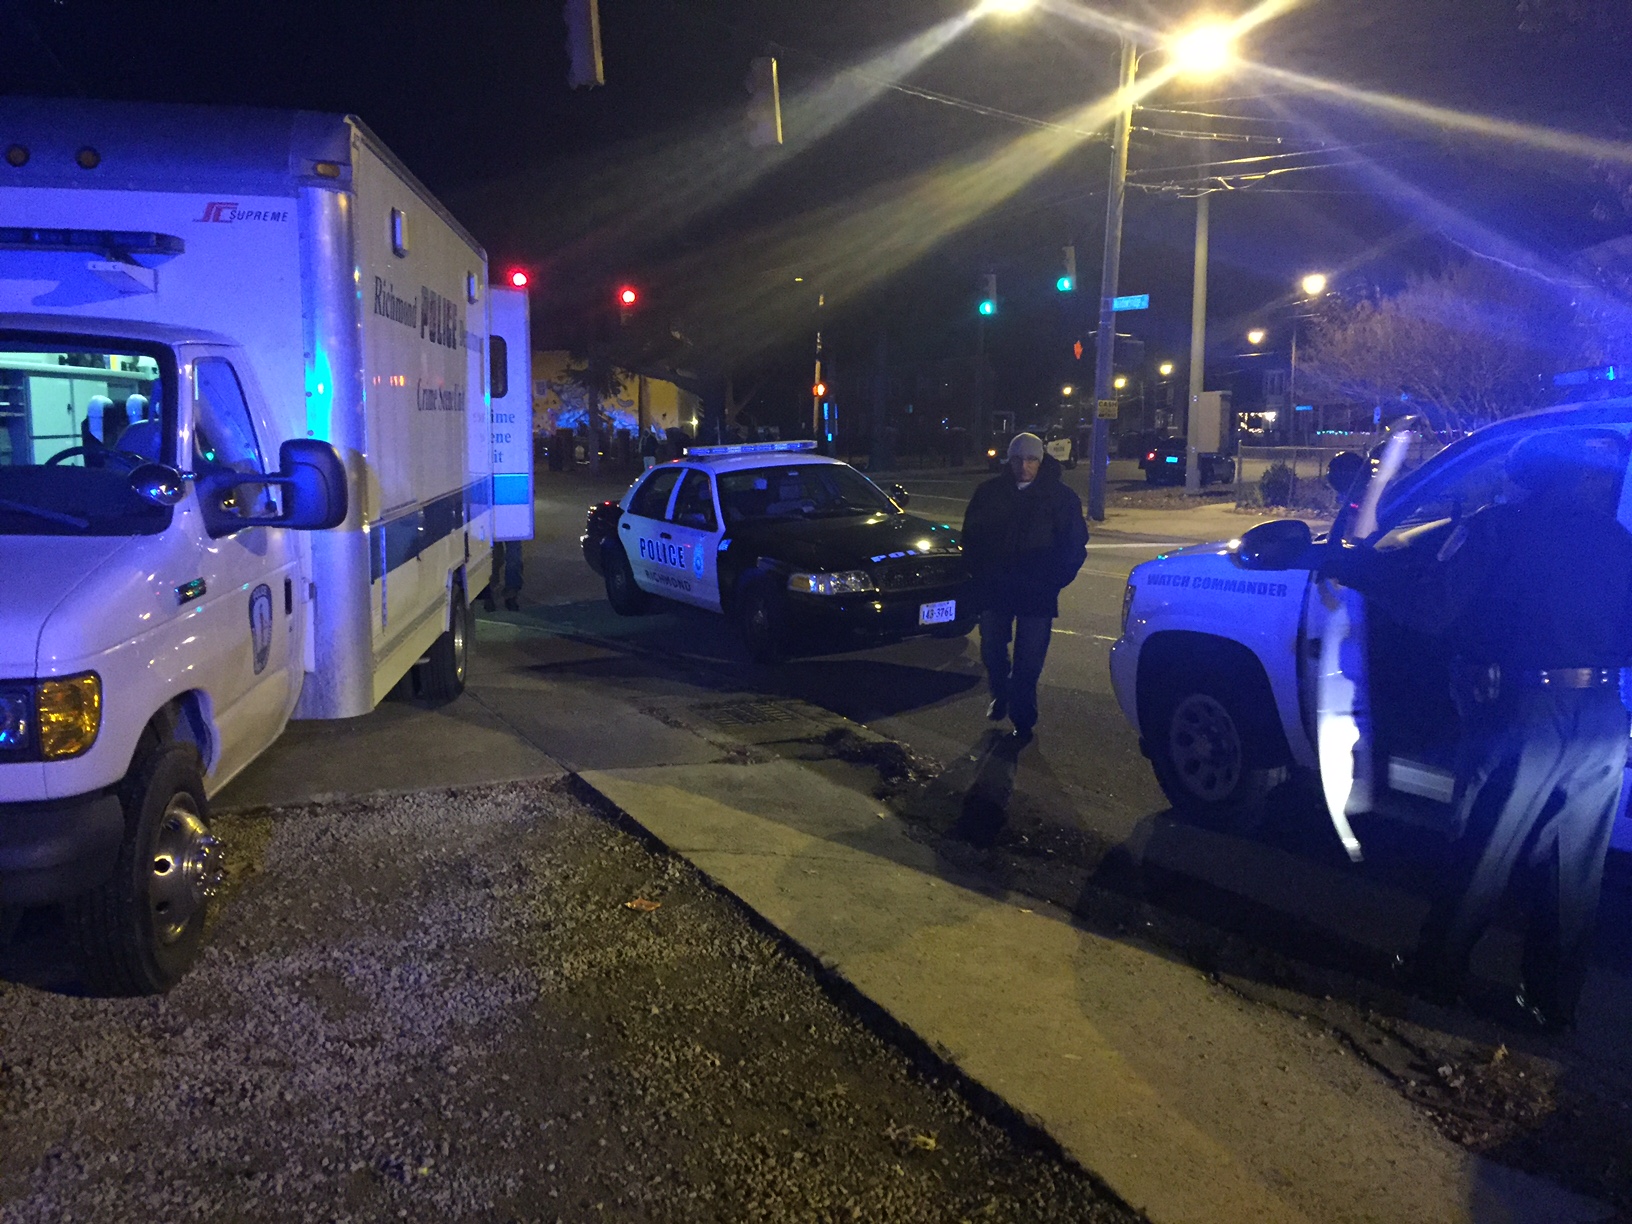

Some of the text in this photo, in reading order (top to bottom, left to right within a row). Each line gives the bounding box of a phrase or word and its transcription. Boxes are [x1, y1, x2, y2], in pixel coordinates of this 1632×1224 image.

[229, 210, 288, 222] SUPREME
[374, 275, 417, 329] Richmond
[420, 285, 458, 350] POLICE
[490, 408, 515, 424] ime
[640, 537, 686, 569] POLICE
[644, 569, 692, 592] RICHMOND
[1147, 573, 1288, 598] WATCH COMMANDER
